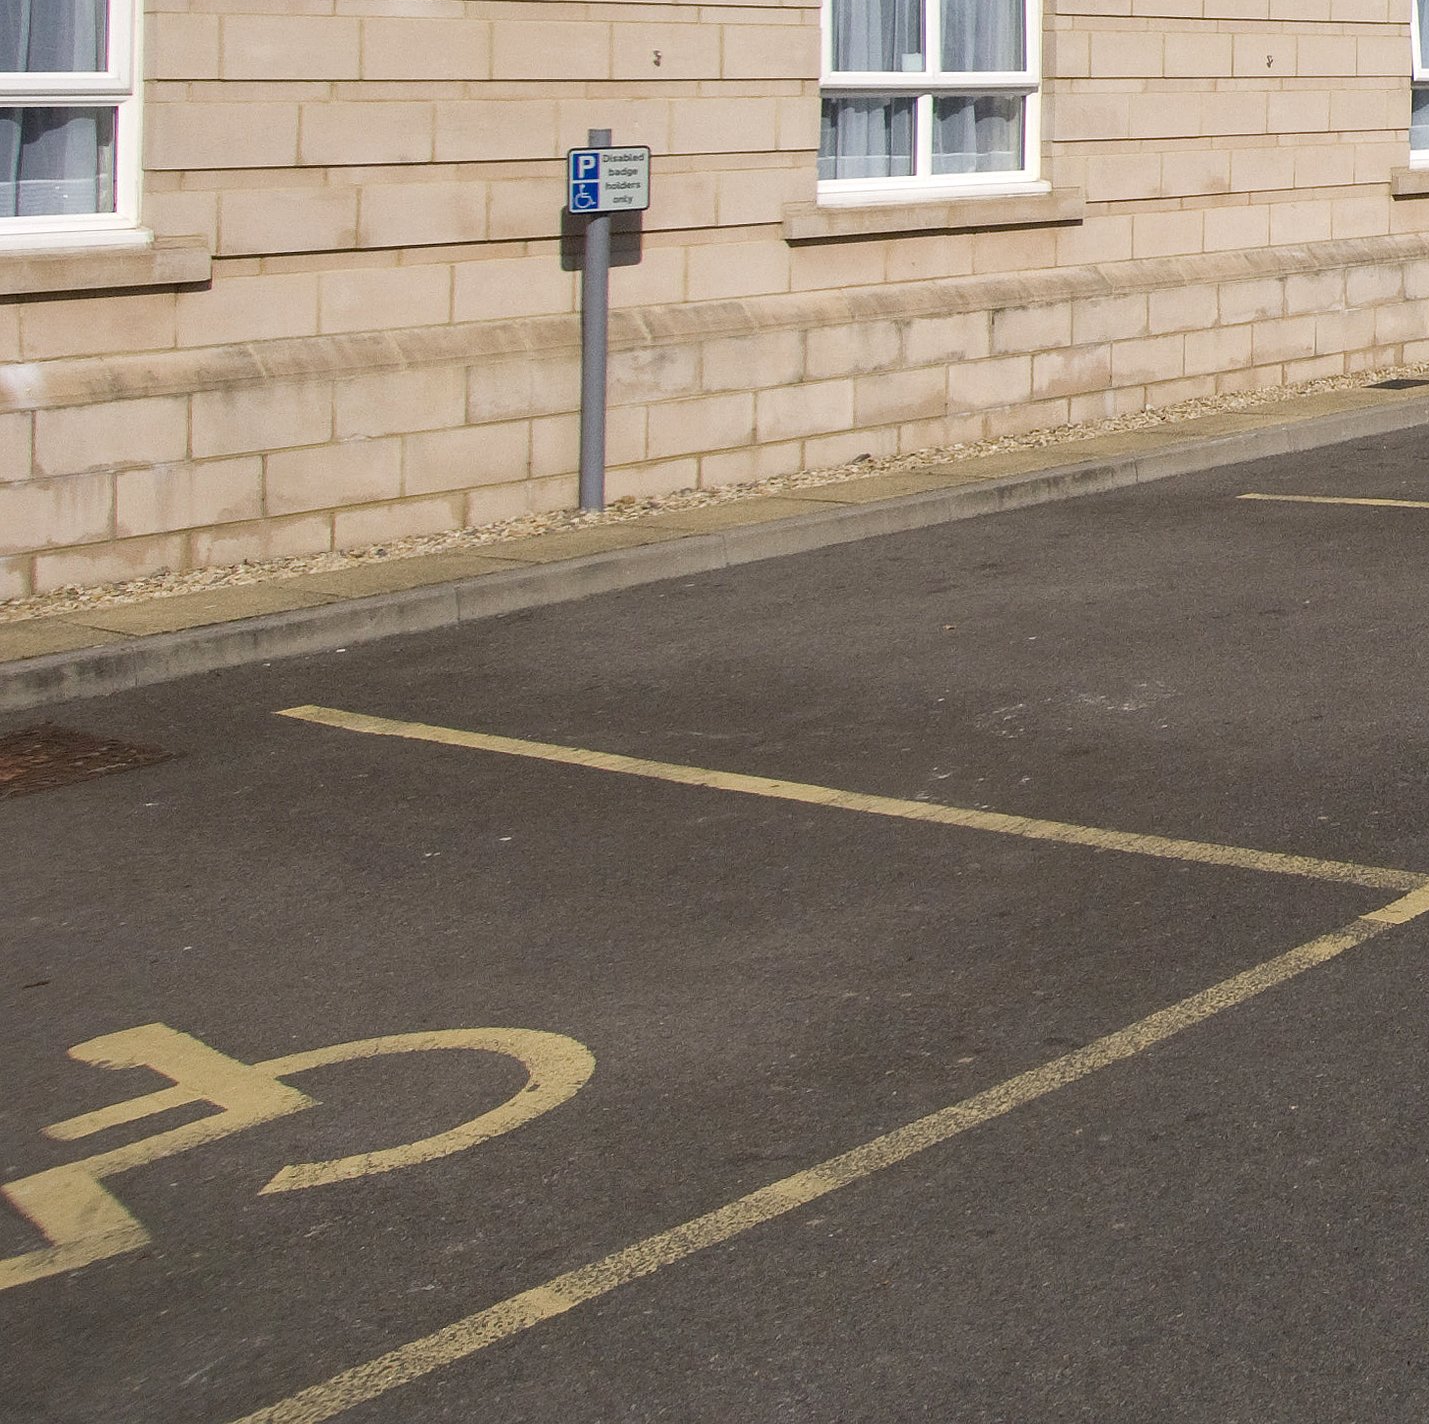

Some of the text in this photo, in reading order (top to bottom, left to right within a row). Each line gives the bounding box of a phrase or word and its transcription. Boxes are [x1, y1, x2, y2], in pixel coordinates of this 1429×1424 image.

[602, 154, 644, 163] Disabled
[578, 155, 596, 179] P
[608, 168, 638, 177] badge
[605, 181, 641, 190] holders
[612, 195, 633, 204] only
